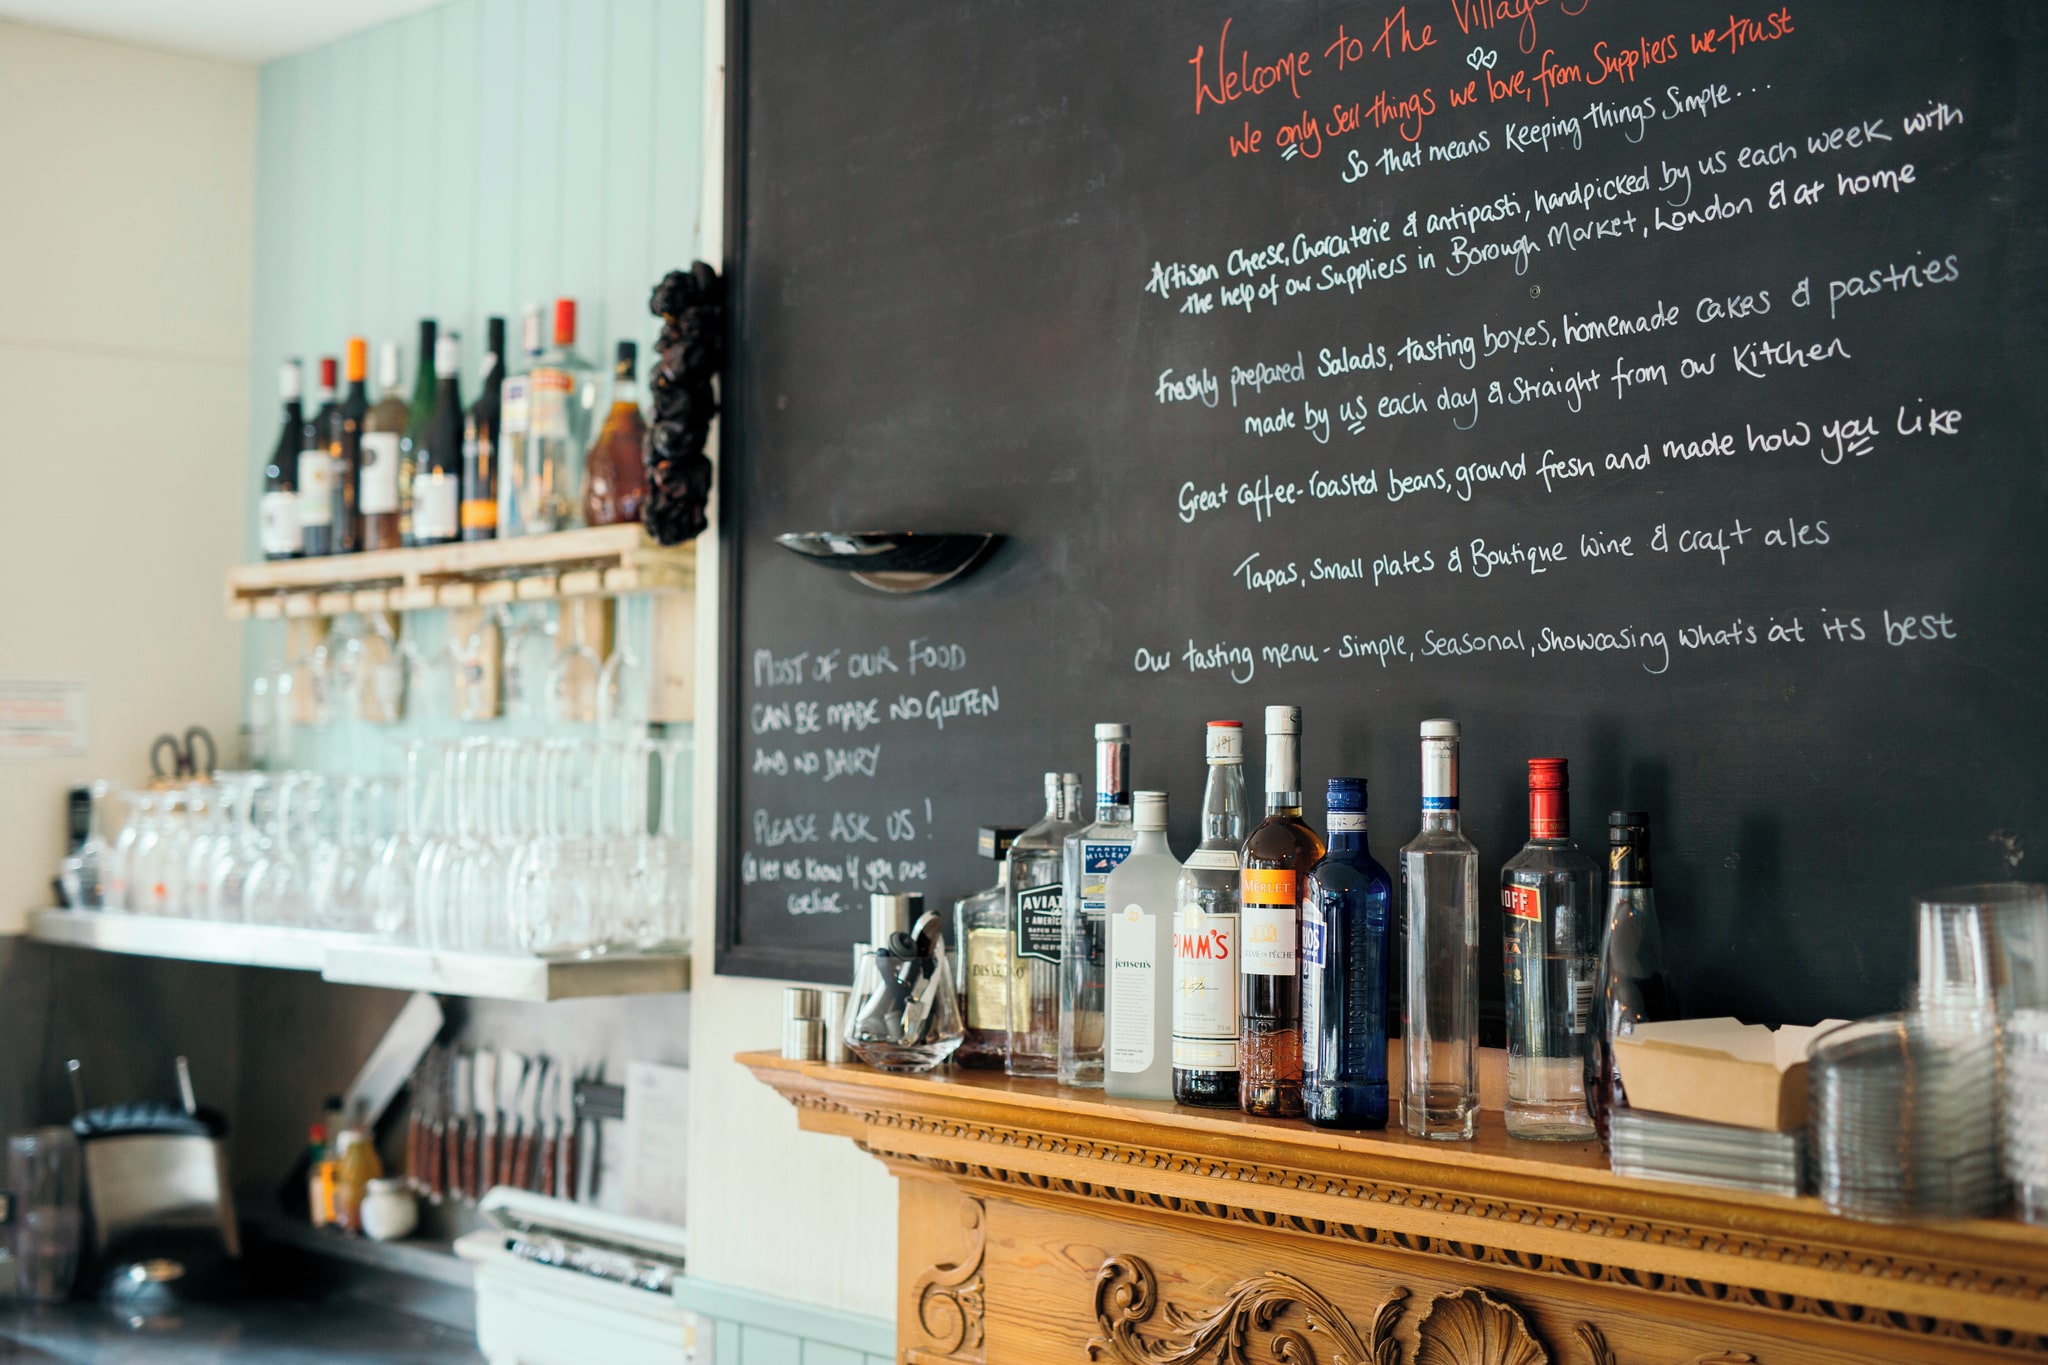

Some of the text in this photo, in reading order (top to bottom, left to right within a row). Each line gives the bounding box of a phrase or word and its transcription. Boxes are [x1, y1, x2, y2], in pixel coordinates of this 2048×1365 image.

[1189, 18, 1312, 115] Welcome
[1325, 25, 1363, 71] to
[1451, 0, 1549, 54] Villag
[1276, 110, 1322, 158] only
[1365, 88, 1436, 143] things
[1486, 66, 1532, 103] love,
[1532, 49, 1581, 107] from
[1717, 7, 1796, 55] trust
[1341, 149, 1369, 183] So
[1375, 142, 1423, 176] that
[1429, 130, 1492, 162] means
[1583, 95, 1656, 143] things
[1145, 260, 1219, 299] Artisan
[1402, 211, 1418, 237] &
[1427, 192, 1531, 232] antipasti,
[1535, 167, 1649, 214] handpicked
[1658, 161, 1692, 207] by
[1699, 150, 1727, 176] us
[1738, 141, 1797, 169] each
[1808, 118, 1893, 154] week
[1903, 99, 1964, 137] with
[1220, 281, 1256, 313] help
[1257, 273, 1278, 306] of
[1285, 276, 1312, 296] our
[1418, 247, 1436, 270] in
[1445, 233, 1541, 276] Borough
[1655, 194, 1754, 232] London
[1768, 180, 1787, 210] &
[1793, 179, 1825, 205] at
[1837, 162, 1917, 197] home
[1155, 367, 1219, 408] Freshly
[1231, 350, 1305, 407] prepared
[1397, 332, 1476, 371] tasting
[1482, 318, 1558, 358] boxes,
[1563, 300, 1680, 345] homemade
[1792, 276, 1811, 308] &
[1830, 251, 1960, 320] pastries
[1245, 407, 1296, 437] made
[1304, 400, 1330, 444] by
[1340, 395, 1368, 428] us
[1377, 392, 1428, 418] each
[1437, 386, 1479, 431] day
[1488, 381, 1503, 404] &
[1611, 356, 1668, 399] from
[1680, 351, 1716, 379] our
[1178, 480, 1228, 523] Great
[1387, 468, 1452, 501] beans,
[1455, 452, 1527, 501] ground
[1535, 450, 1595, 492] fresh
[1606, 445, 1650, 470] and
[1664, 432, 1735, 460] made
[1747, 422, 1811, 452] how
[1820, 415, 1880, 465] you
[1233, 553, 1306, 592] Tapas,
[1373, 550, 1435, 586] plates
[1448, 546, 1463, 573] &
[1470, 538, 1568, 579] Boutique
[1581, 532, 1635, 558] wine
[1650, 523, 1668, 553] &
[1679, 519, 1753, 566] craft
[1764, 518, 1831, 547] ales
[812, 648, 841, 683] OF
[848, 646, 898, 679] OUR
[908, 637, 966, 676] FOOD
[1134, 648, 1171, 673] Our
[1183, 639, 1255, 685] tasting
[1537, 625, 1669, 673] Showcasing
[1680, 619, 1757, 646] what's
[1768, 617, 1805, 643] at
[1884, 609, 1958, 646] best
[752, 702, 791, 734] CAN
[795, 701, 821, 734] BE
[890, 695, 923, 721] NO
[926, 685, 999, 730] GLUTEN
[793, 752, 819, 775] NO
[823, 744, 881, 782] DAIRY
[830, 811, 878, 843] ASK
